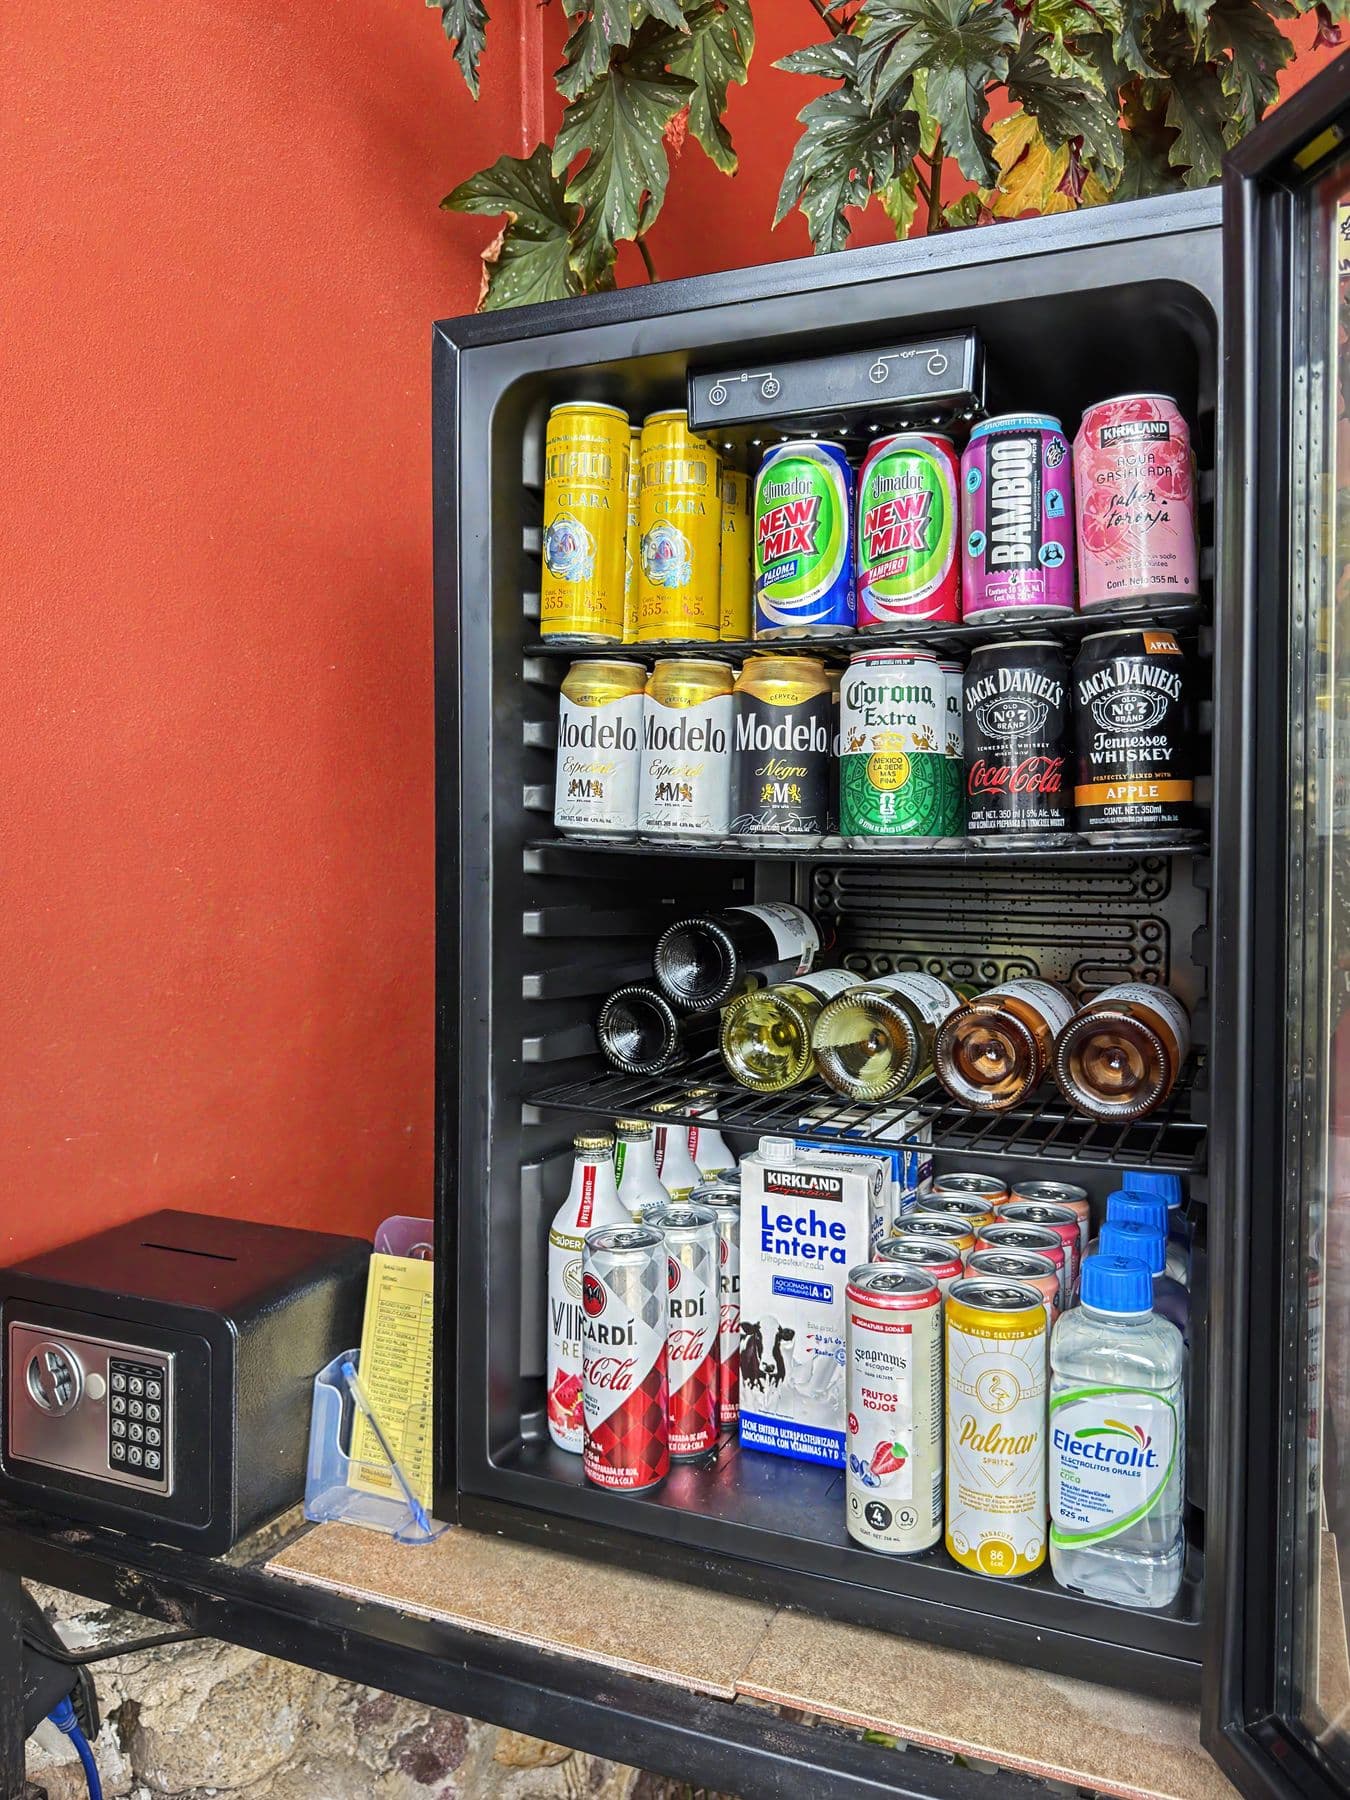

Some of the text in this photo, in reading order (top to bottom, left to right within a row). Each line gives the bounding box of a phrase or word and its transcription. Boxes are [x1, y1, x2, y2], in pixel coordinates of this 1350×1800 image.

[1103, 423, 1168, 440] KIRKLAND
[1117, 453, 1156, 467] AGUA
[1096, 466, 1173, 485] GASIFICADA
[558, 492, 610, 509] CLARA
[654, 499, 706, 516] CLARA
[991, 440, 1033, 564] BAMBOO
[1103, 482, 1156, 519] sabor
[758, 497, 816, 543] NEW
[863, 493, 927, 540] NEW
[1107, 507, 1171, 533] toronja
[762, 521, 816, 565] MIX
[869, 517, 926, 560] MIX
[763, 561, 796, 582] PALOMA
[1106, 579, 1128, 590] Cont.
[1150, 575, 1166, 584] 355
[965, 675, 998, 712] JACK
[998, 668, 1064, 710] DANIEL'S
[1078, 661, 1183, 706] JACK DANIEL'S
[846, 680, 934, 714] Corona
[864, 707, 917, 727] Extra
[1017, 709, 1029, 721] 7
[1136, 702, 1149, 714] 7
[997, 721, 1025, 730] BRAND
[1115, 714, 1144, 723] BRAND
[559, 712, 637, 752] Modelo
[642, 714, 727, 754] Modelo
[735, 712, 828, 753] Modelo
[1093, 732, 1168, 750] Tennessee
[1089, 748, 1174, 765] WHISKEY
[754, 758, 809, 781] Negra
[578, 778, 591, 798] M
[665, 782, 681, 802] M
[772, 782, 790, 803] M
[1106, 784, 1160, 799] APPLE
[766, 1172, 841, 1192] KIRKLAND
[761, 1204, 847, 1241] Leche
[761, 1230, 847, 1265] Entera
[760, 1252, 825, 1271] Ultrapasteurizada
[811, 1285, 820, 1298] A
[823, 1286, 832, 1300] D
[855, 1347, 907, 1370] Seagram's
[861, 1387, 899, 1403] FRUTOS
[863, 1398, 897, 1413] ROJOS
[741, 1429, 839, 1460] ADICIONADA CON VITAMINAS A Y D
[758, 1423, 779, 1438] ENTERA
[780, 1428, 840, 1450] ULTRAPASTEURIZADA
[959, 1414, 1038, 1456] Palmar
[1060, 1454, 1142, 1478] ELECTROLITOS ORALES
[872, 1508, 883, 1522] 4
[1059, 1508, 1090, 1523] 625 mL
[990, 1549, 1004, 1560] 86
